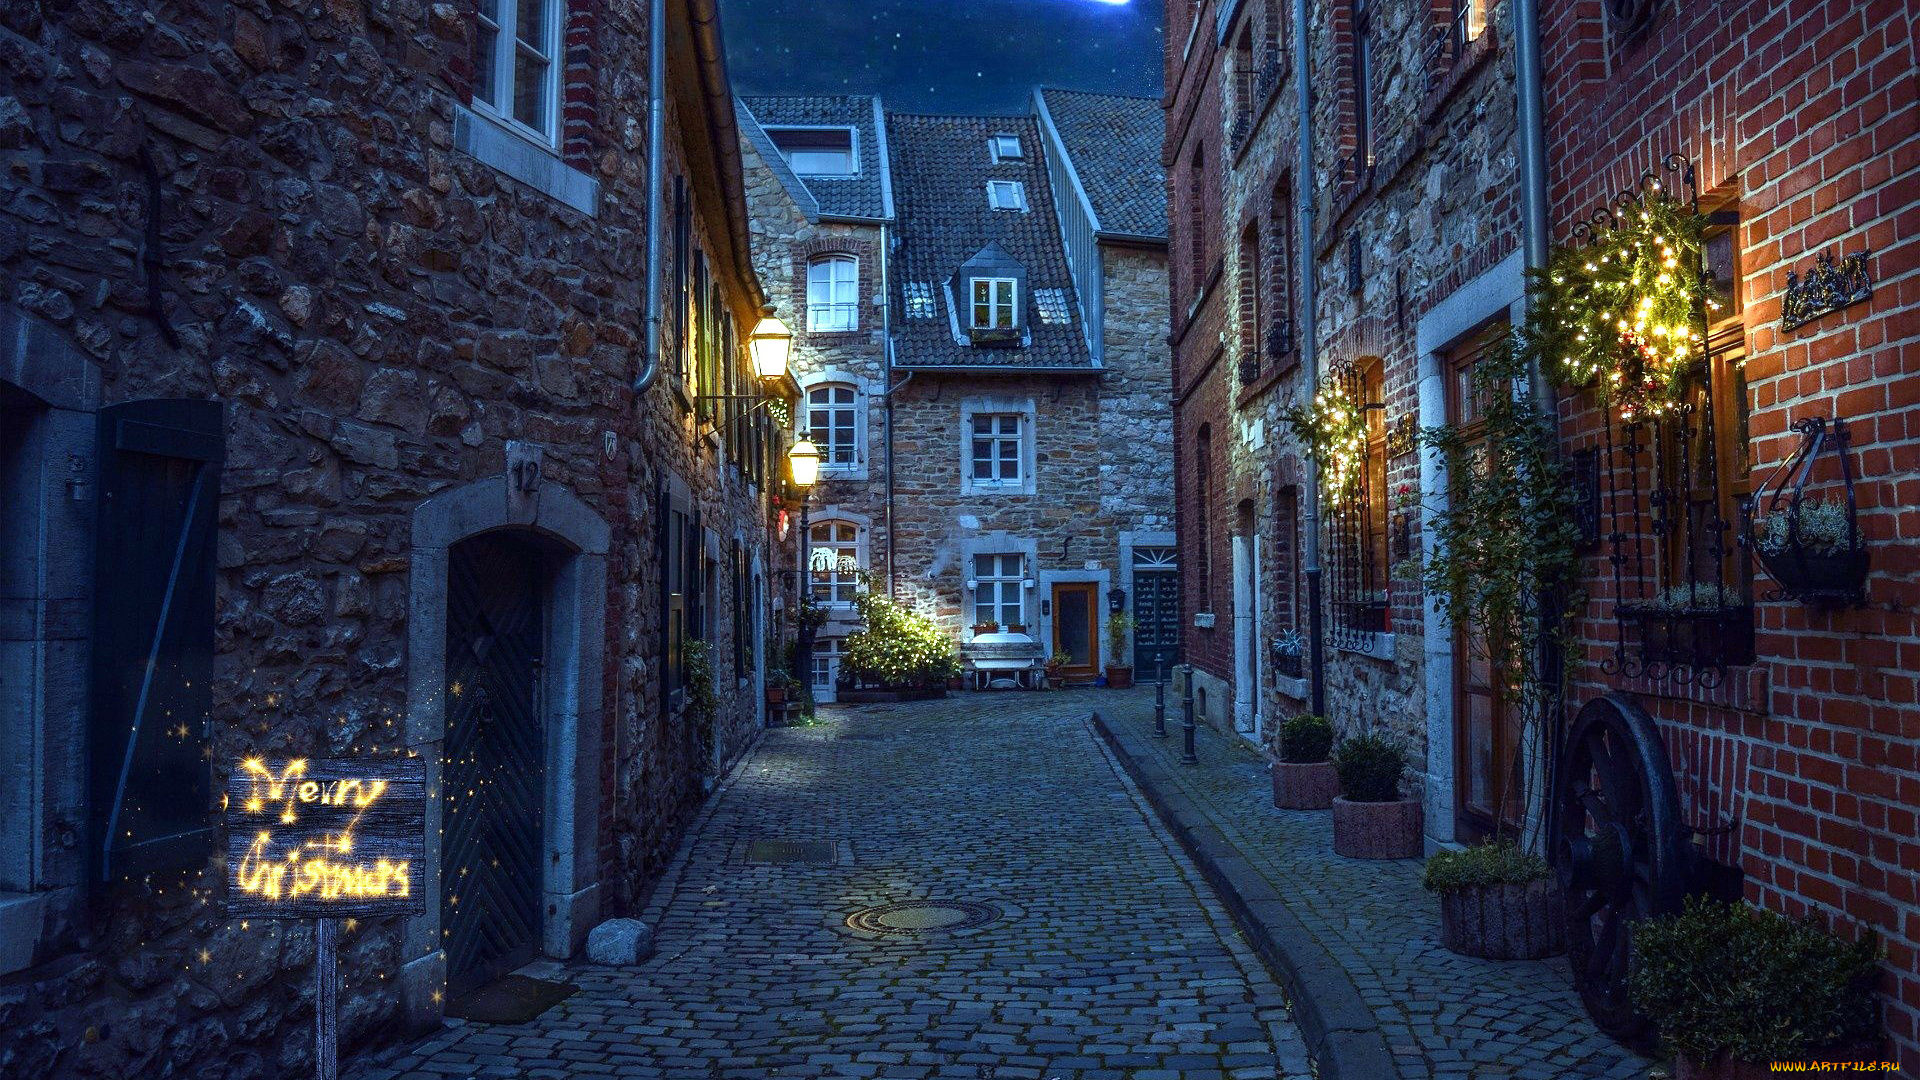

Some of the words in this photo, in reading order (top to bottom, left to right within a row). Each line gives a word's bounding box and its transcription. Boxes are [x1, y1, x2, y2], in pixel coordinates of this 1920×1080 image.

[512, 460, 539, 492] 12
[239, 754, 389, 850] Merry
[238, 831, 411, 901] Christmas
